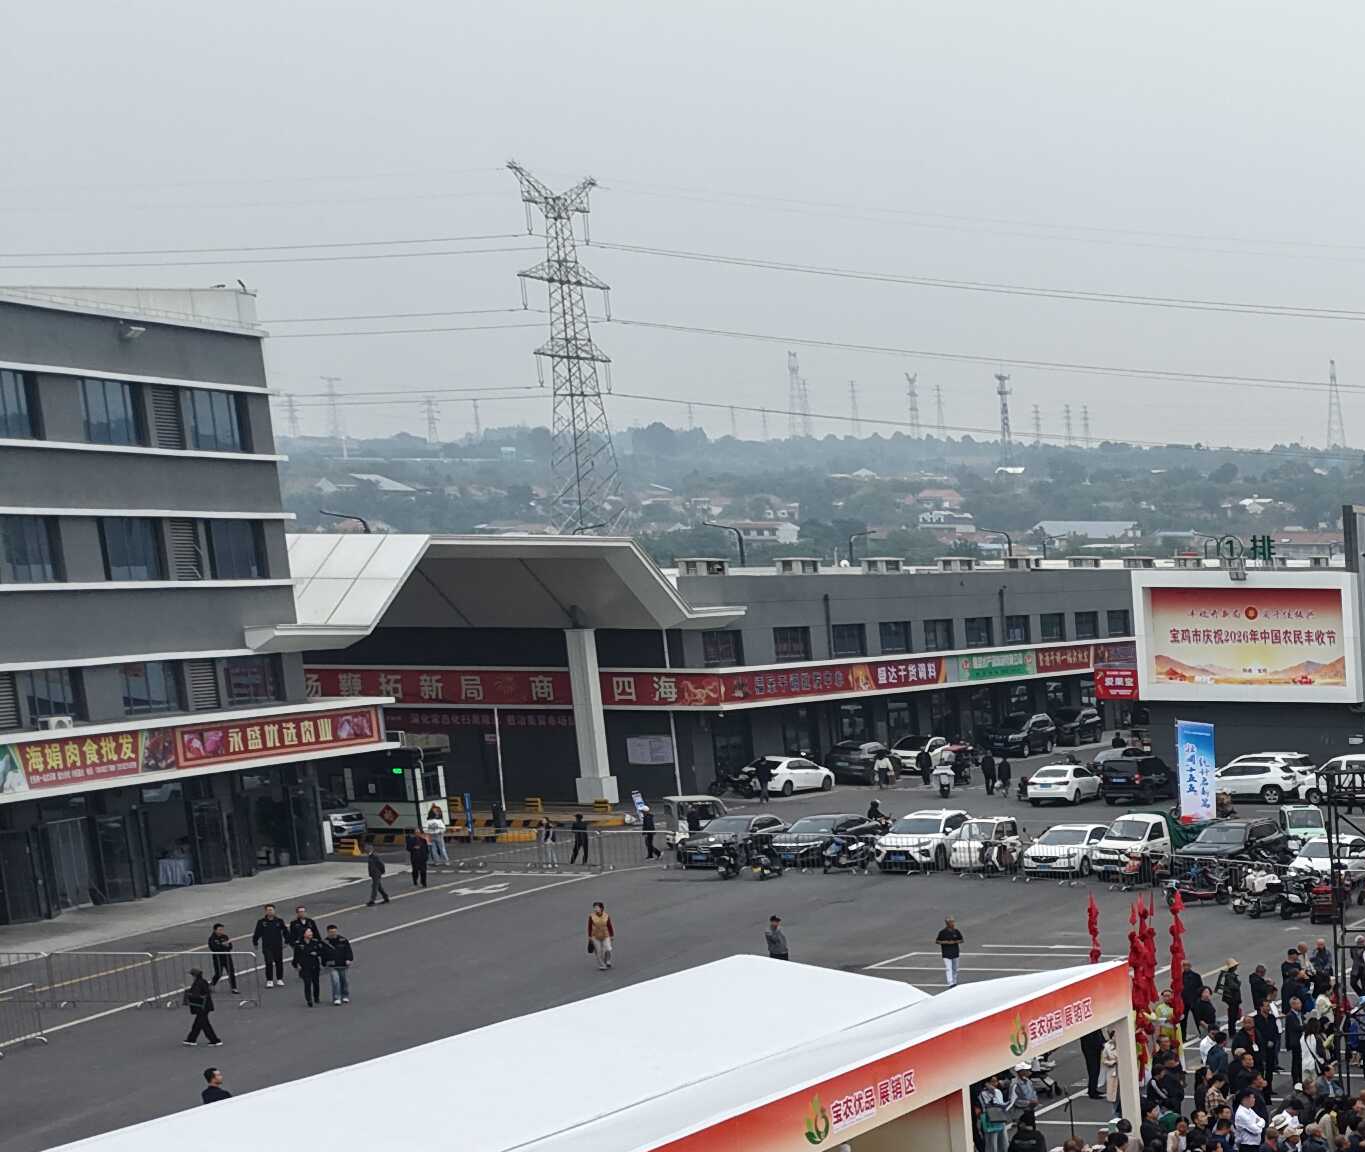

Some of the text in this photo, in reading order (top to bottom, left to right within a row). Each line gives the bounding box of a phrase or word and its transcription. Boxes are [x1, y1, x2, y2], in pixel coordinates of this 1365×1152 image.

[529, 674, 678, 702] 商四海
[831, 1069, 915, 1127] 宝农优品 展销区
